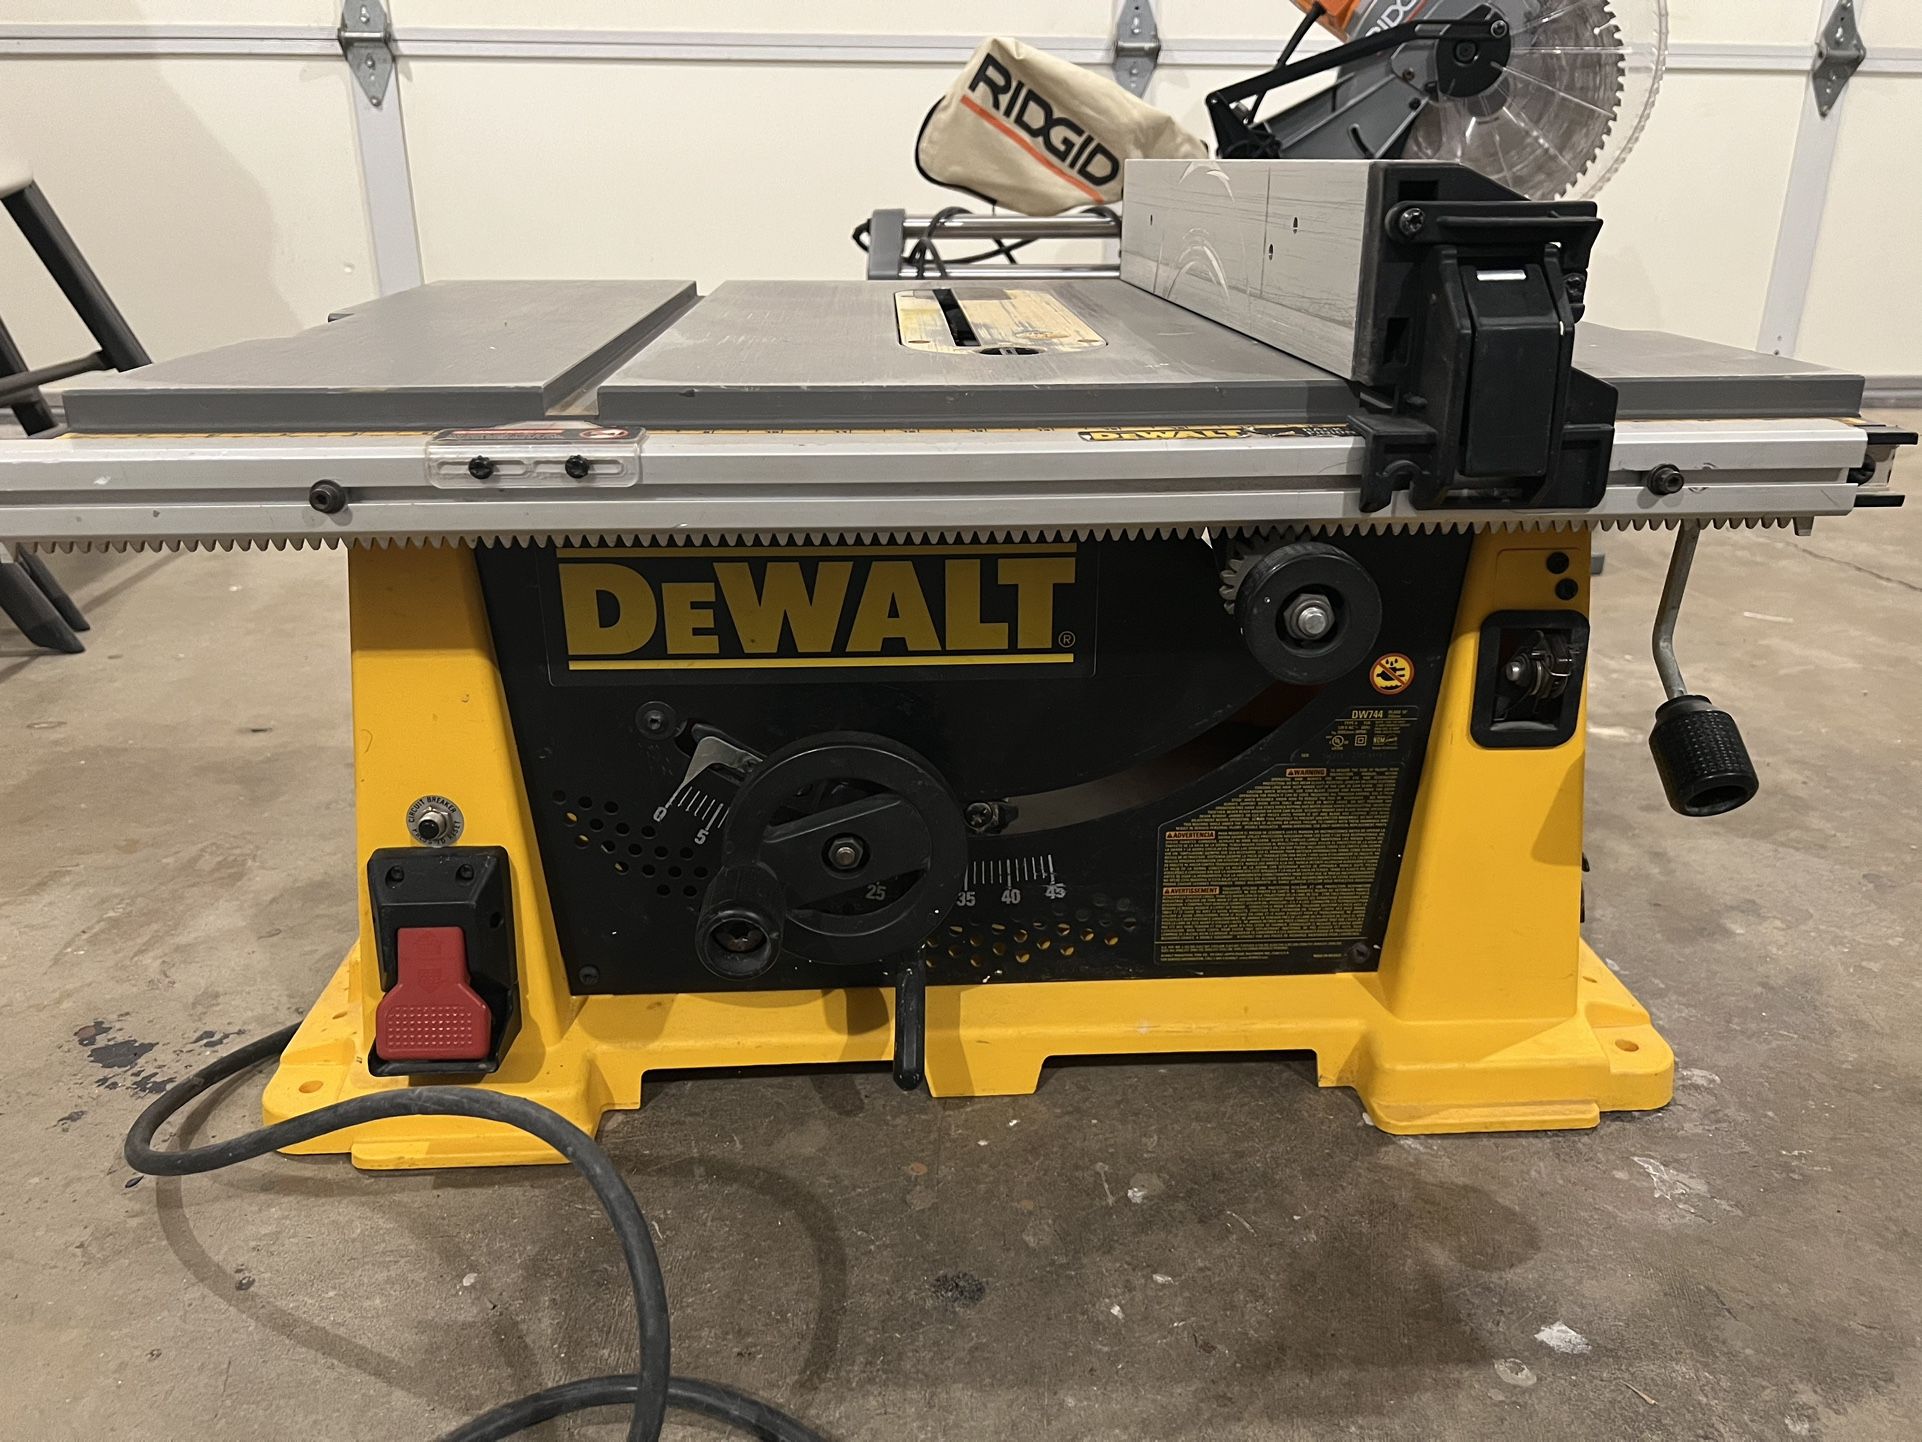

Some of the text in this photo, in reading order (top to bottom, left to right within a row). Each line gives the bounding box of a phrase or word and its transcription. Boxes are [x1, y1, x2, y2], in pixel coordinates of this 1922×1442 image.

[968, 53, 1120, 186] RIDGID
[1352, 710, 1383, 719] DW744
[408, 796, 457, 823] CIRCUIT BREAKER
[694, 829, 709, 845] 5
[866, 884, 887, 901] 25
[956, 883, 1067, 907] 35 40 45
